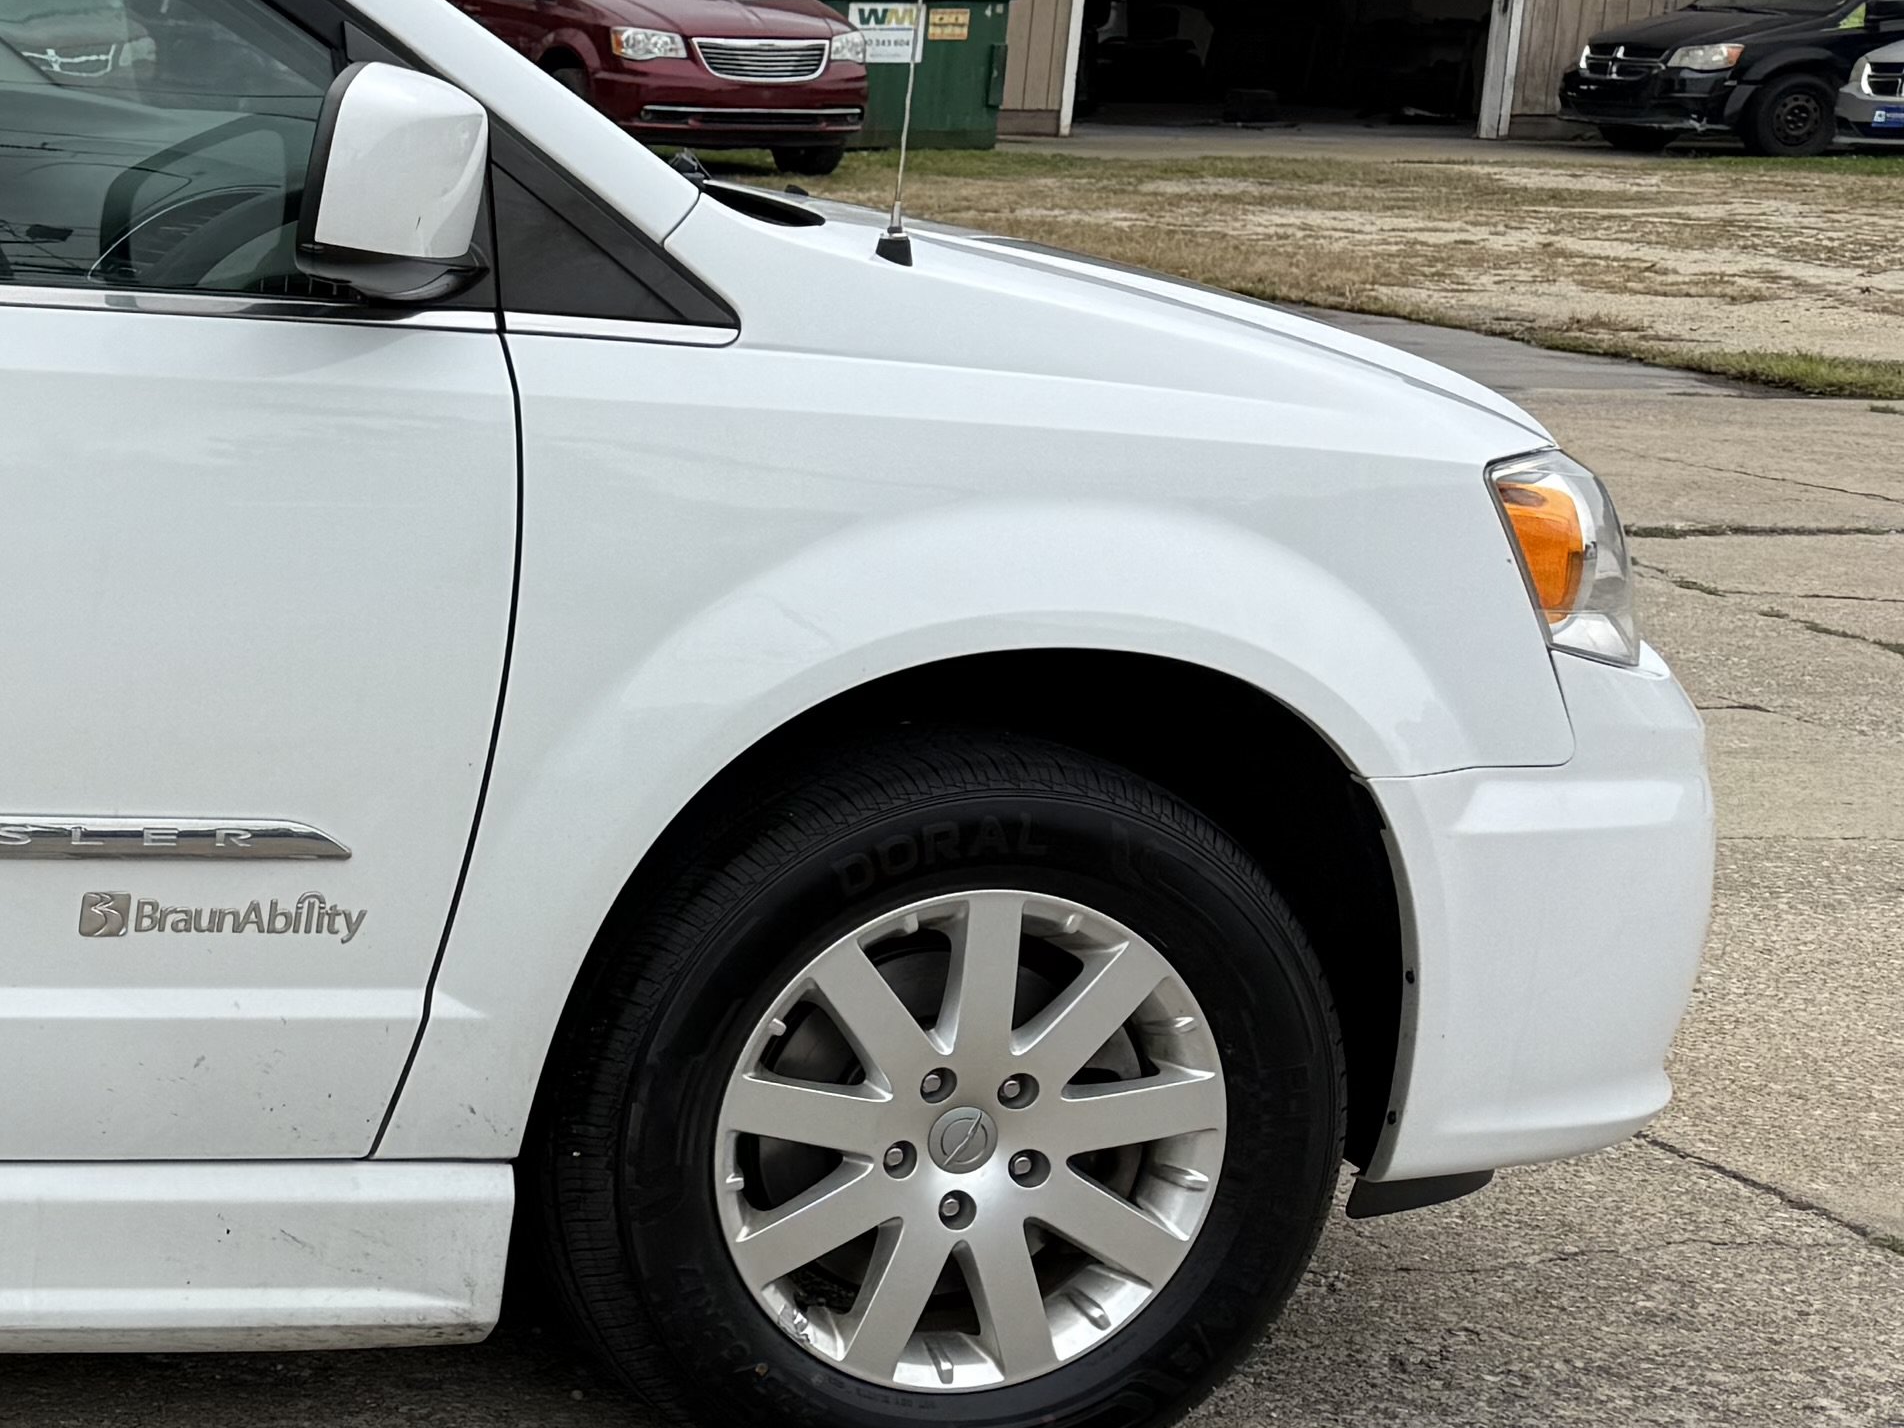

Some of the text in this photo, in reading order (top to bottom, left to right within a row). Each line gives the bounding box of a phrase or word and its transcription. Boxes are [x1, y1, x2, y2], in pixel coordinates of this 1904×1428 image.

[858, 8, 917, 25] WM
[833, 813, 1050, 895] DORAL
[135, 892, 367, 943] BraunAbility
